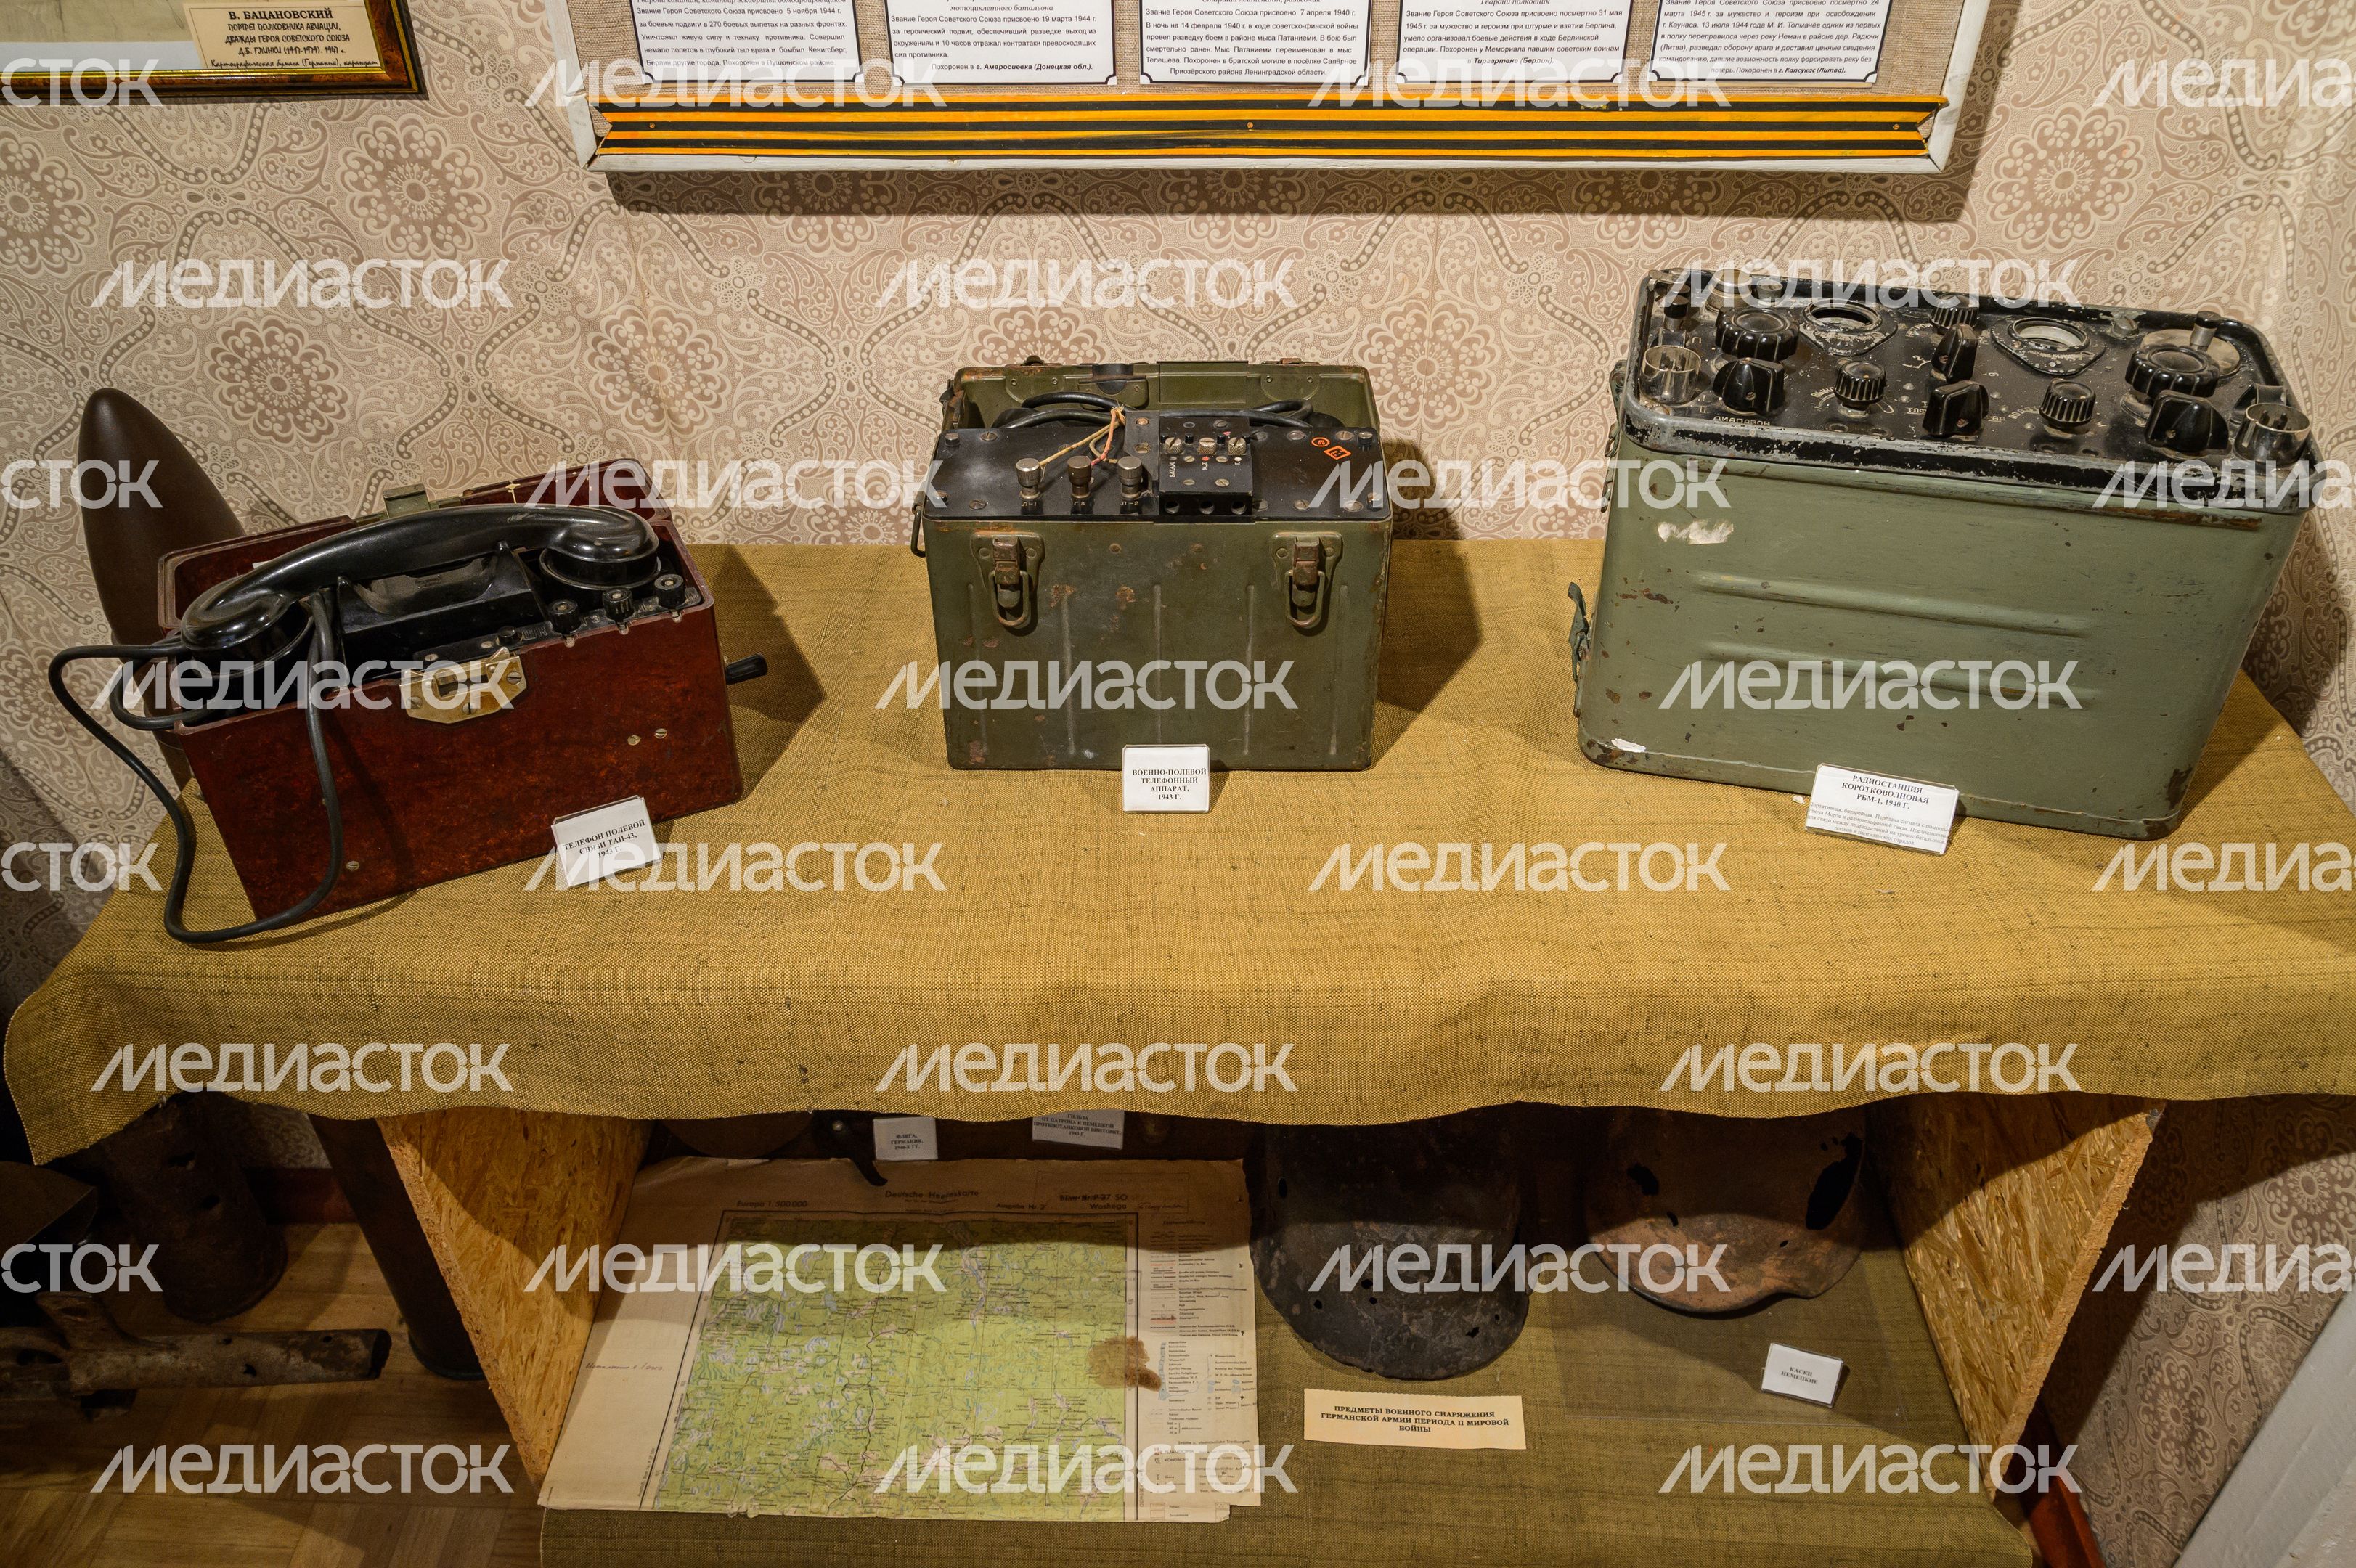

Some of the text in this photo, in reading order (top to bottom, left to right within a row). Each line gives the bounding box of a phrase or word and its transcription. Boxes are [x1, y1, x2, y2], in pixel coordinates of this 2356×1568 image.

[242, 7, 333, 20] БАЦАНОВСКИЙ
[662, 7, 682, 15] Героя
[683, 7, 722, 15] Советского
[722, 7, 746, 15] Союза
[792, 7, 817, 15] ноября
[1234, 9, 1258, 17] Союза
[1334, 9, 1350, 17] 1940
[227, 21, 341, 33] ПОРТРЕТ ПОЛКОВНИКА АВИАЦИИ,
[224, 35, 256, 46] ДВАЖДЫ
[257, 34, 280, 43] ГЕРОЯ
[326, 33, 350, 42] СОЮЗА
[1243, 68, 1295, 77] Ленинградской
[1853, 775, 1923, 794] РАДИОСТАНЦИЯ
[1842, 783, 1929, 804] КОРОТКОВОЛНОВАЯ
[1856, 793, 1883, 805] РБМ-1,
[1885, 799, 1901, 808] 1940
[563, 820, 645, 851] ТЕЛЕФОН ПОЛЕВОЙ
[1781, 1371, 1818, 1384] НЕМЕЦКИЕ
[1790, 1366, 1813, 1377] КАСКИ
[1334, 1405, 1383, 1414] ПРЕДМЕТЫ
[1321, 1413, 1379, 1422] ГЕРМАНСКОЙ
[1381, 1416, 1412, 1424] АРМИИ
[1467, 1418, 1509, 1426] МИРОВОЙ
[1399, 1424, 1431, 1433] ВОЙНЫ
